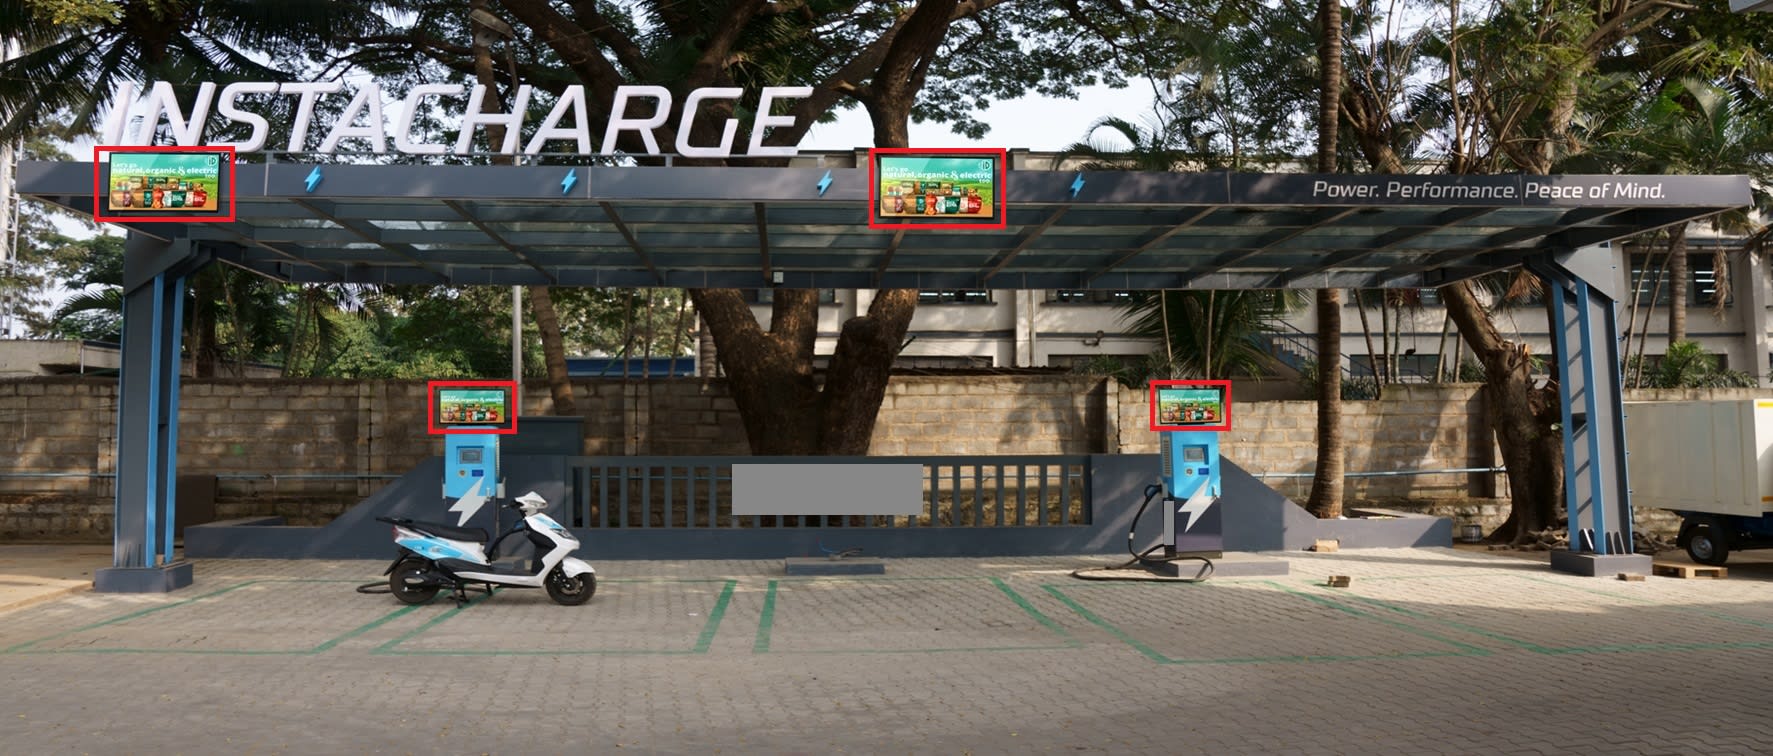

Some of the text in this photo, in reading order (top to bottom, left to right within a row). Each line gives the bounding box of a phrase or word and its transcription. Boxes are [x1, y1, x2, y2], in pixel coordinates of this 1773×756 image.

[102, 81, 814, 157] INSTACHARGE
[178, 166, 186, 176] &
[917, 171, 949, 180] organic
[950, 170, 959, 179] &
[960, 171, 992, 179] electric
[1312, 180, 1665, 199] Power. Performance. Peace of Mind.
